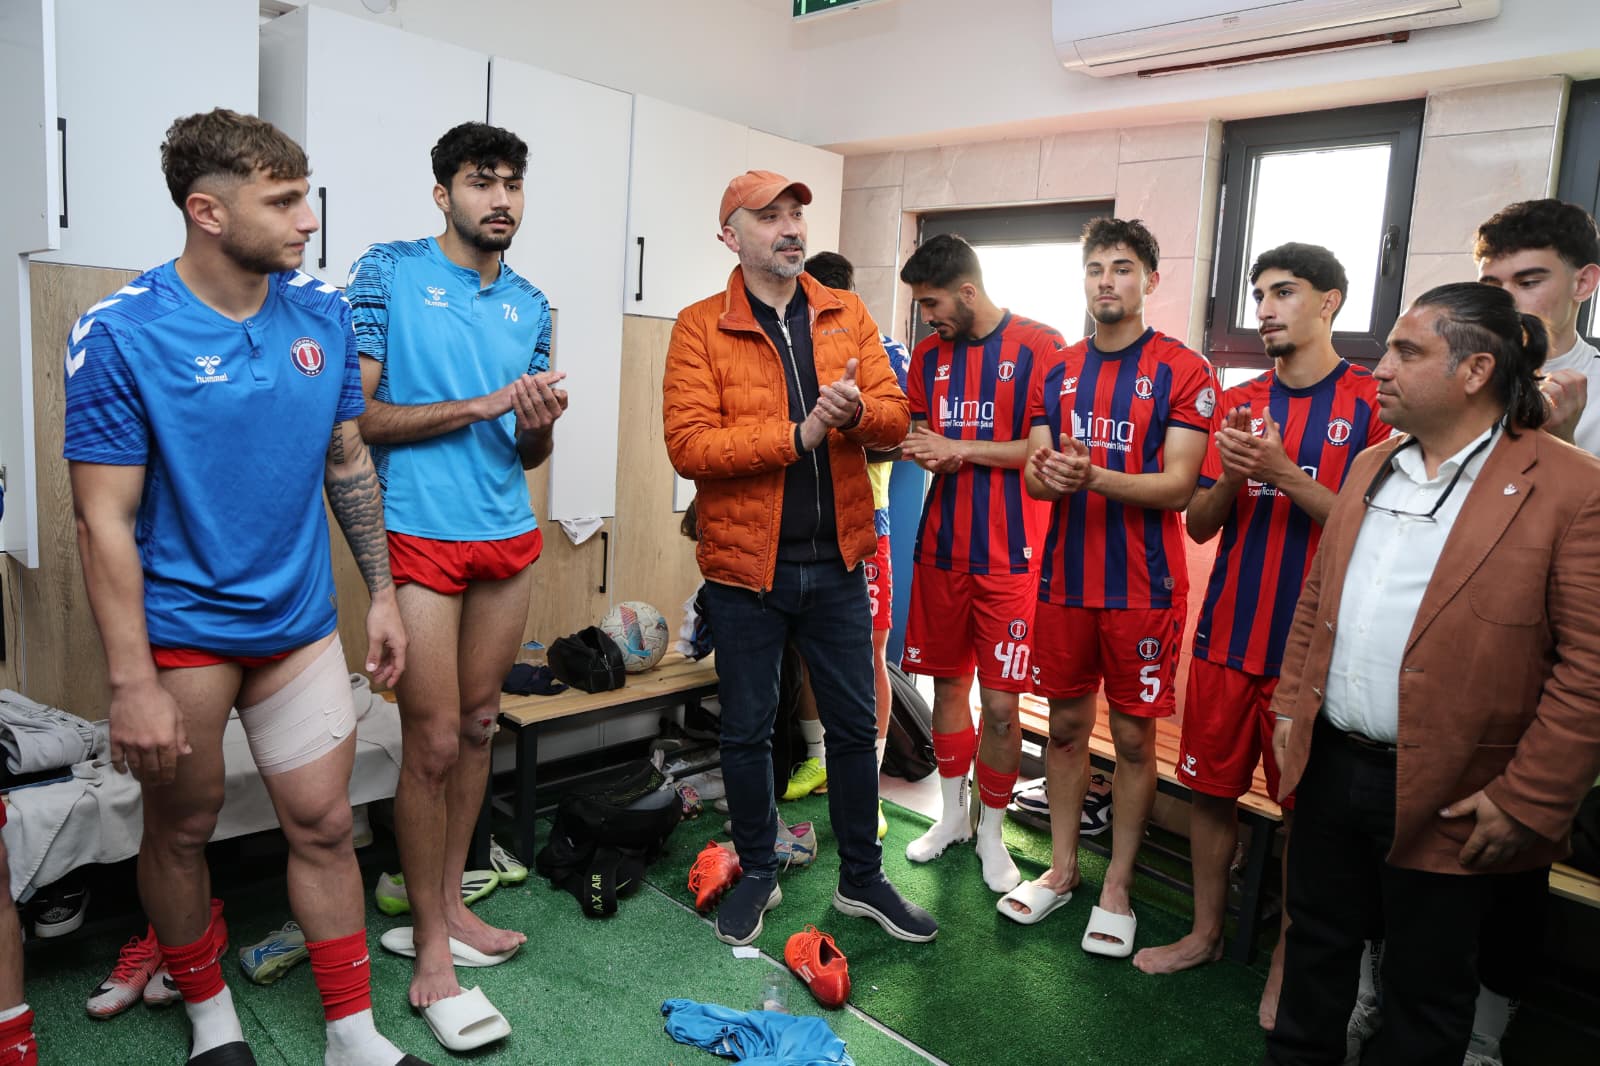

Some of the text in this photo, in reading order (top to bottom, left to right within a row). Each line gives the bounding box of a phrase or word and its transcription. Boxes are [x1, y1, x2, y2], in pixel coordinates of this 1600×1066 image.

[502, 303, 519, 322] 76
[195, 373, 229, 384] hummel
[939, 395, 995, 420] Lima
[1071, 409, 1135, 444] Lima
[994, 640, 1030, 681] 40
[1139, 664, 1161, 703] 5
[591, 874, 604, 911] AX AIR
